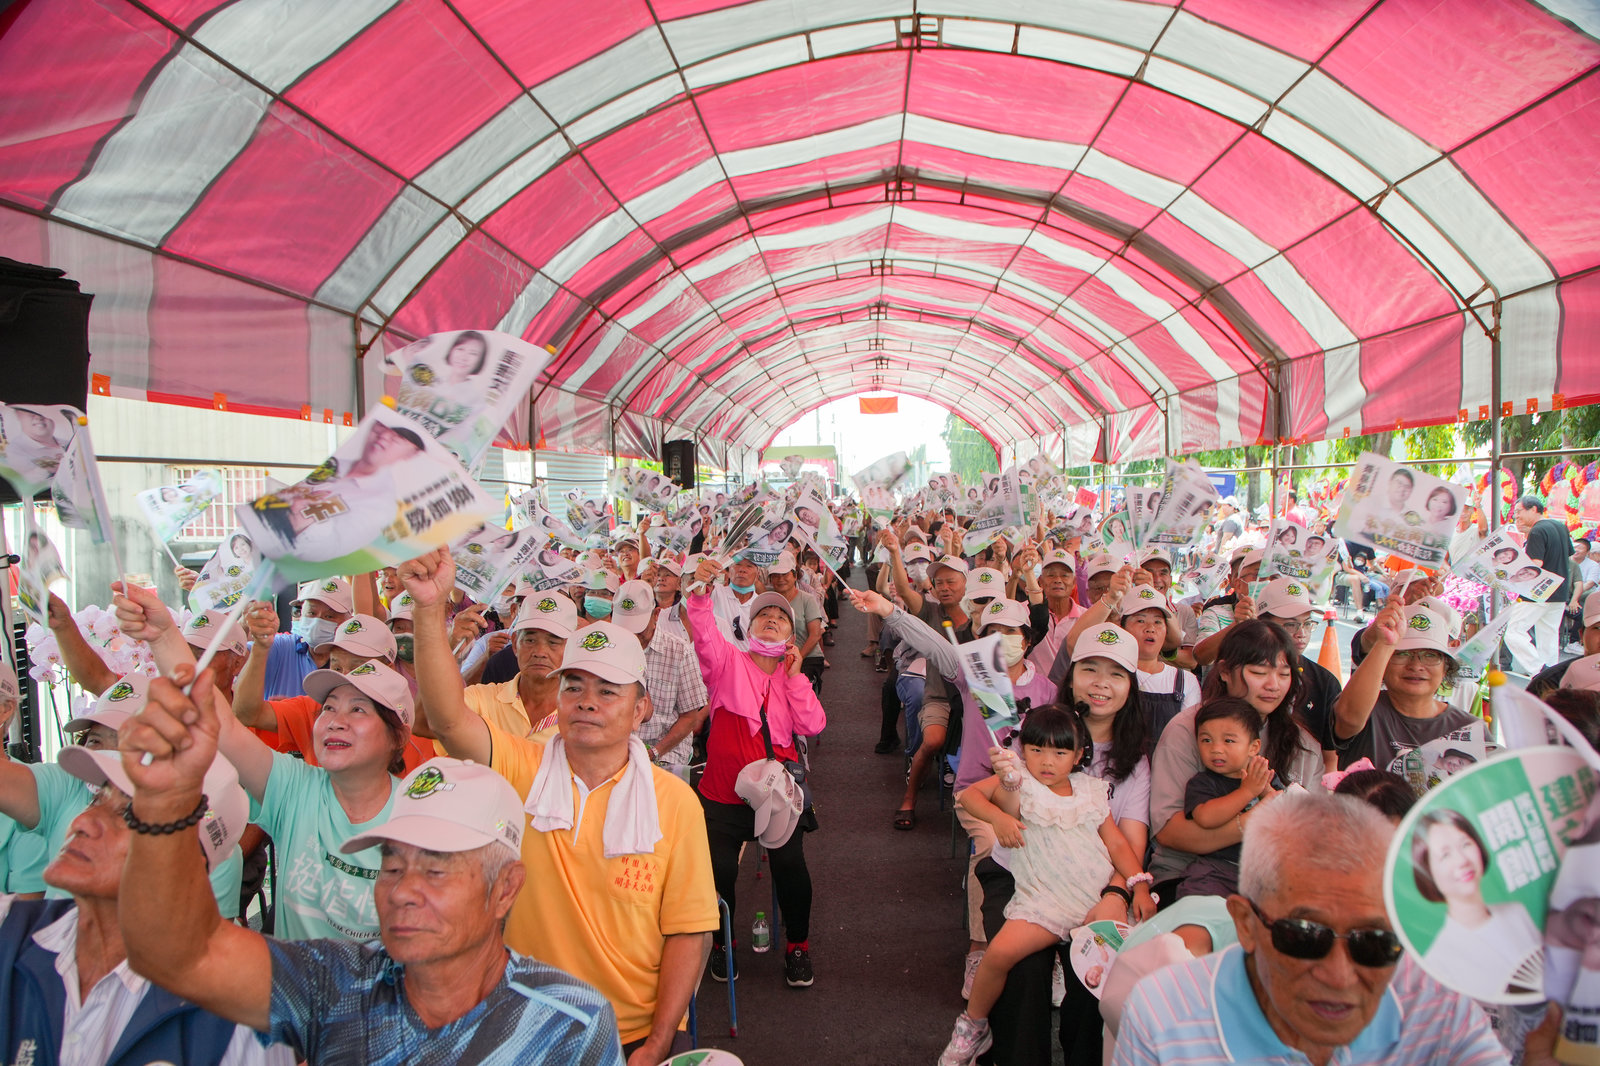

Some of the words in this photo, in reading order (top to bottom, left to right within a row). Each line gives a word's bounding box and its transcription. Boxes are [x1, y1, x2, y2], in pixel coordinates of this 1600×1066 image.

[621, 856, 658, 873] 財團法人
[327, 917, 343, 933] TEAM
[345, 930, 371, 939] CHIEH
